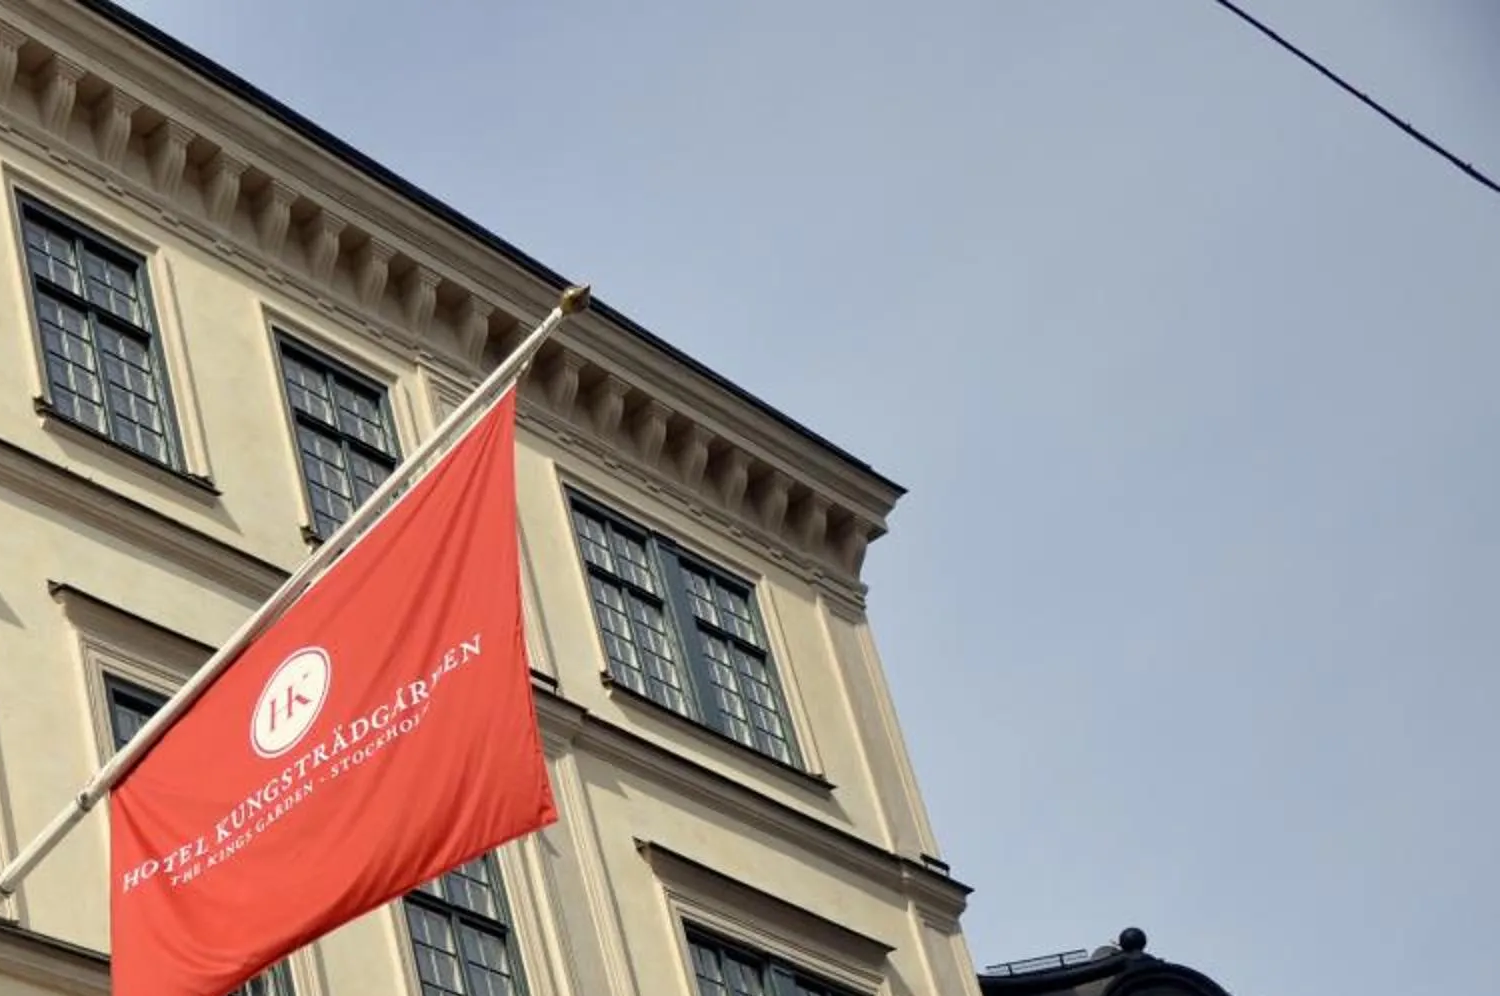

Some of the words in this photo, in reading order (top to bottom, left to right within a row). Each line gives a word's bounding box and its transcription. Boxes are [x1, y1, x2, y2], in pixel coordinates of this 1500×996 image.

[123, 836, 209, 894] HOTEL
[170, 863, 202, 887] THE
[206, 828, 253, 868] KINGS
[255, 779, 314, 834] GARDEN
